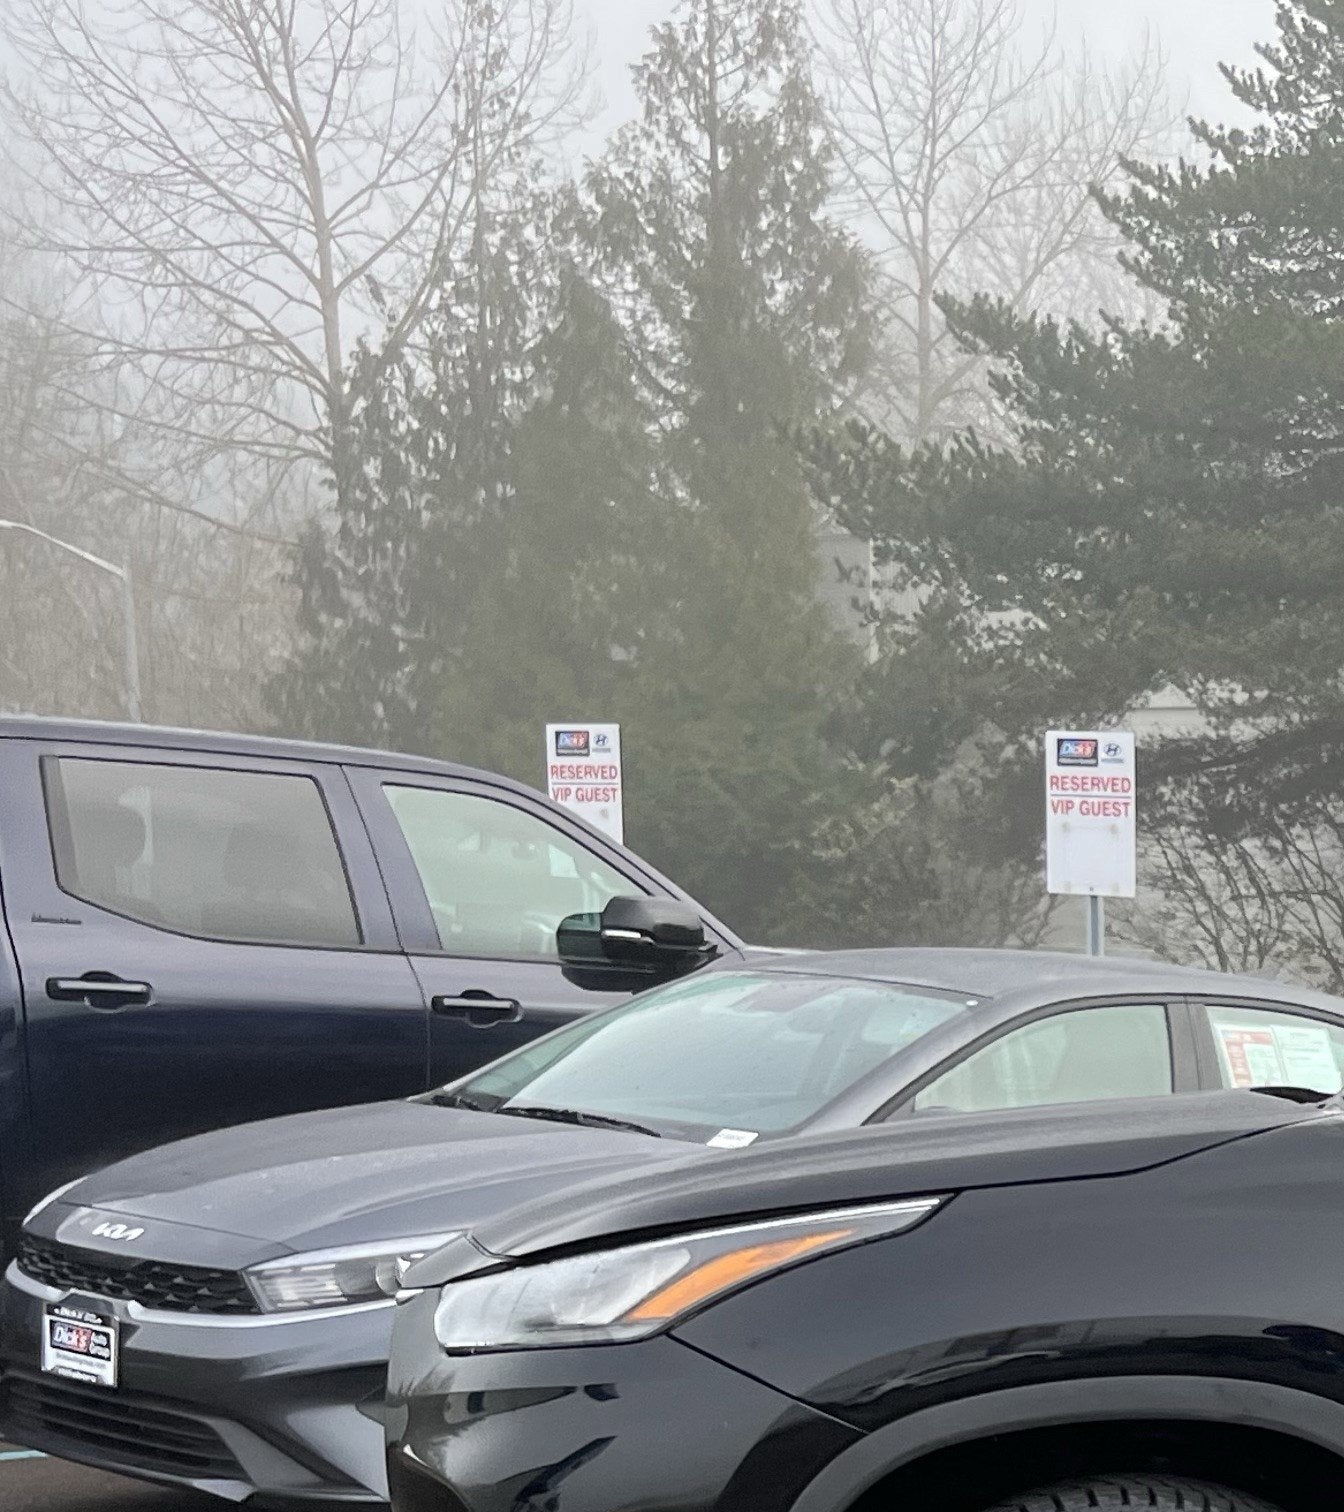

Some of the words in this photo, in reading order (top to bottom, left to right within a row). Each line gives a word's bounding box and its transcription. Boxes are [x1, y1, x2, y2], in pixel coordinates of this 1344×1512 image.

[550, 765, 618, 780] RESERVED
[1050, 775, 1132, 793] RESERVED
[552, 786, 572, 801] VIP
[575, 786, 618, 802] GUEST
[1051, 799, 1075, 816] VIP
[1079, 800, 1131, 818] GUEST
